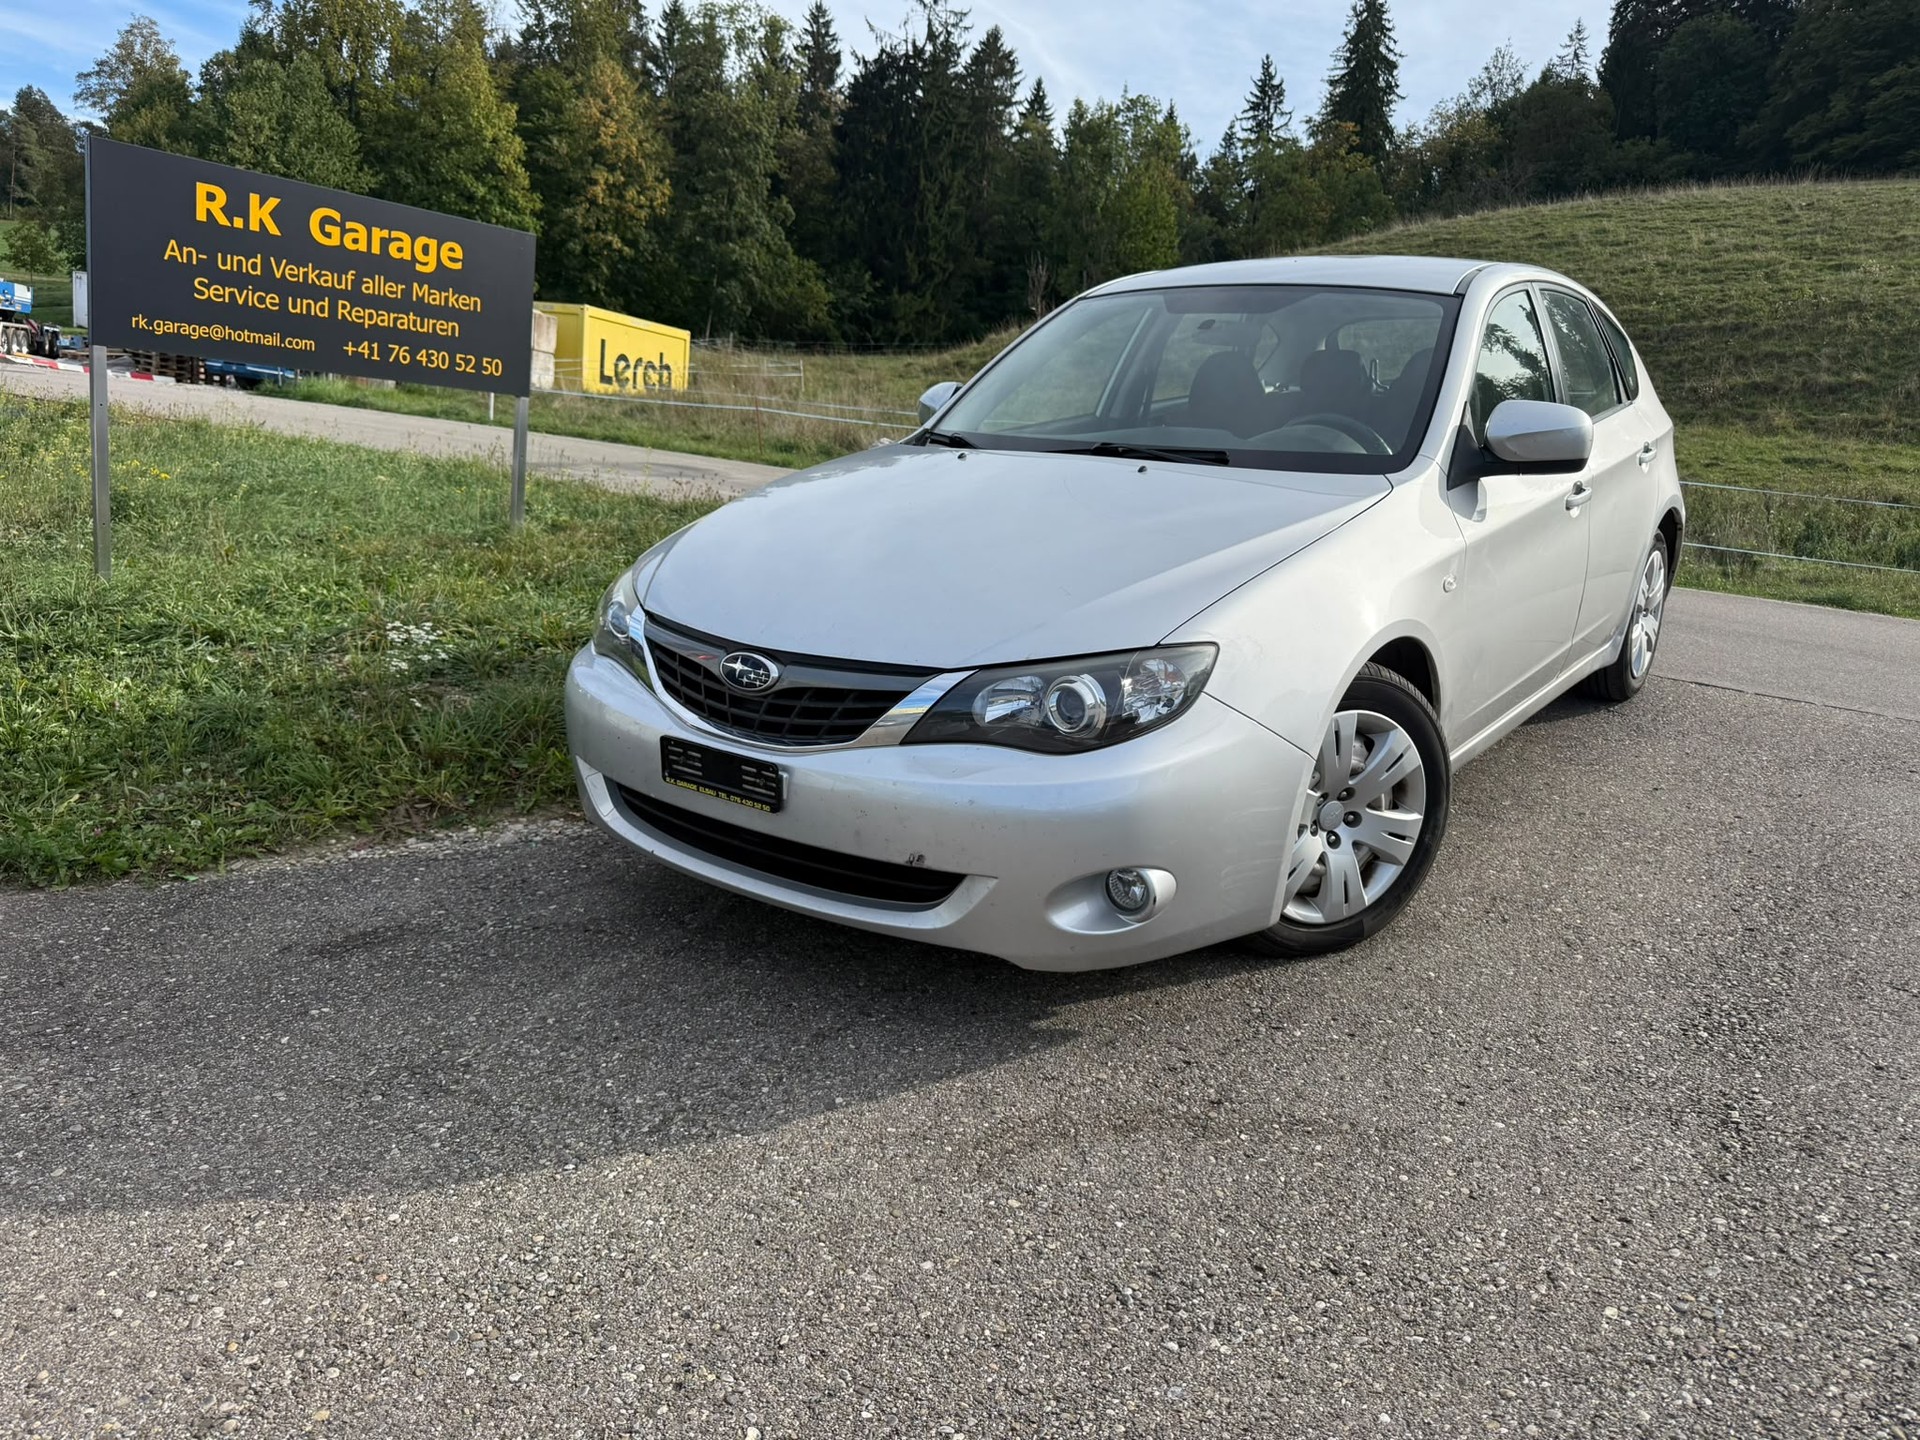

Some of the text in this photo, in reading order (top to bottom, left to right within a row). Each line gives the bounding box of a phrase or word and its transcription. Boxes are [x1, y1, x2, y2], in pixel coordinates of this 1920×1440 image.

[196, 182, 463, 273] R.K Garage
[164, 240, 481, 312] An- und Verkauf aller Marken
[194, 277, 459, 336] Service und Reparaturen
[132, 316, 502, 376] rk.garage@hotmail.com +41 76 430 52 50
[600, 338, 672, 389] Lerch
